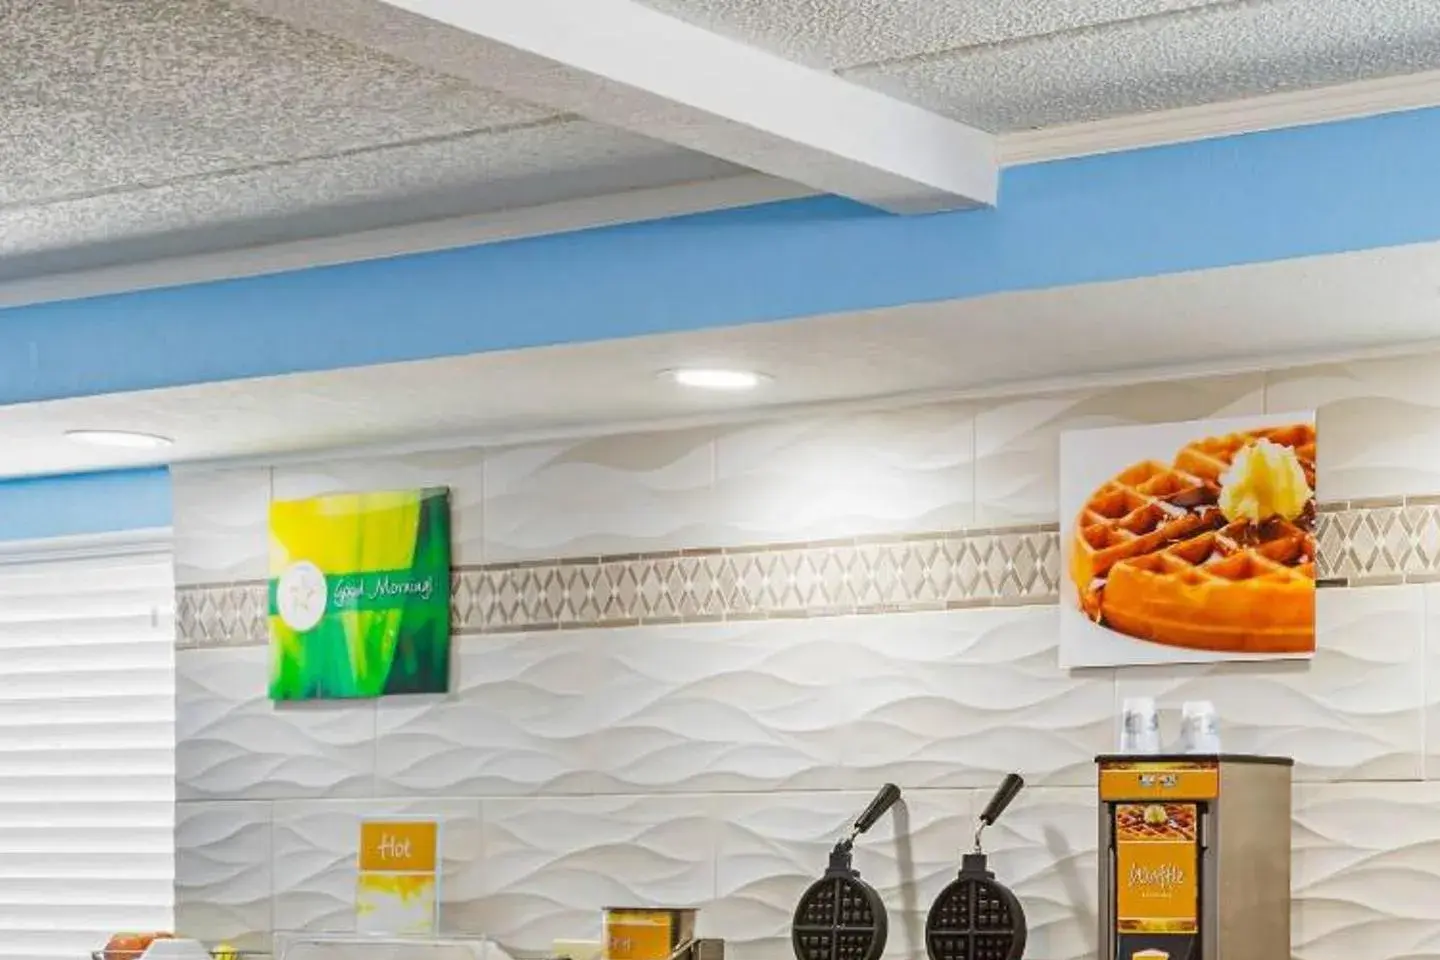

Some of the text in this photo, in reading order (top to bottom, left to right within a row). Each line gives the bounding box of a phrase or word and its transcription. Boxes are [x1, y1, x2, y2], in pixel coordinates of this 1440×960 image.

[334, 574, 433, 607] Good Morning
[377, 831, 412, 860] Hot
